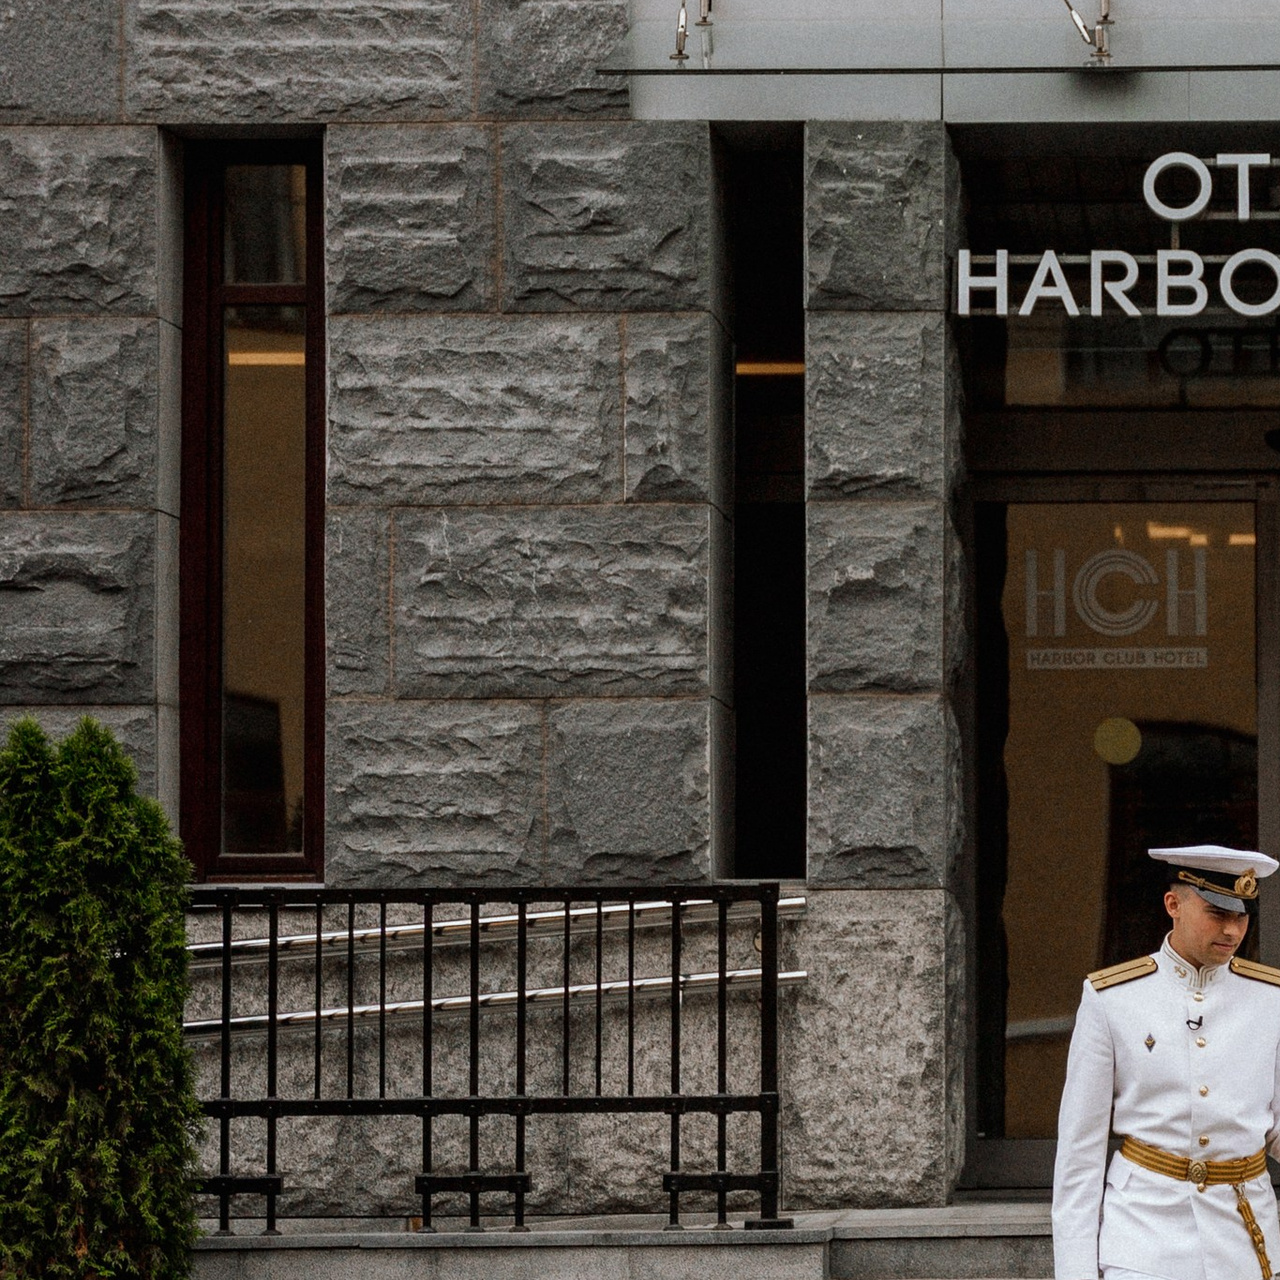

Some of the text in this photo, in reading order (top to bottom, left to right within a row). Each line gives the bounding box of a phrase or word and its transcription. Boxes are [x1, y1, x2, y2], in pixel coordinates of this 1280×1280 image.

[1025, 548, 1208, 638] HCH
[1029, 649, 1206, 667] HARBOR CLUB HOTEL
